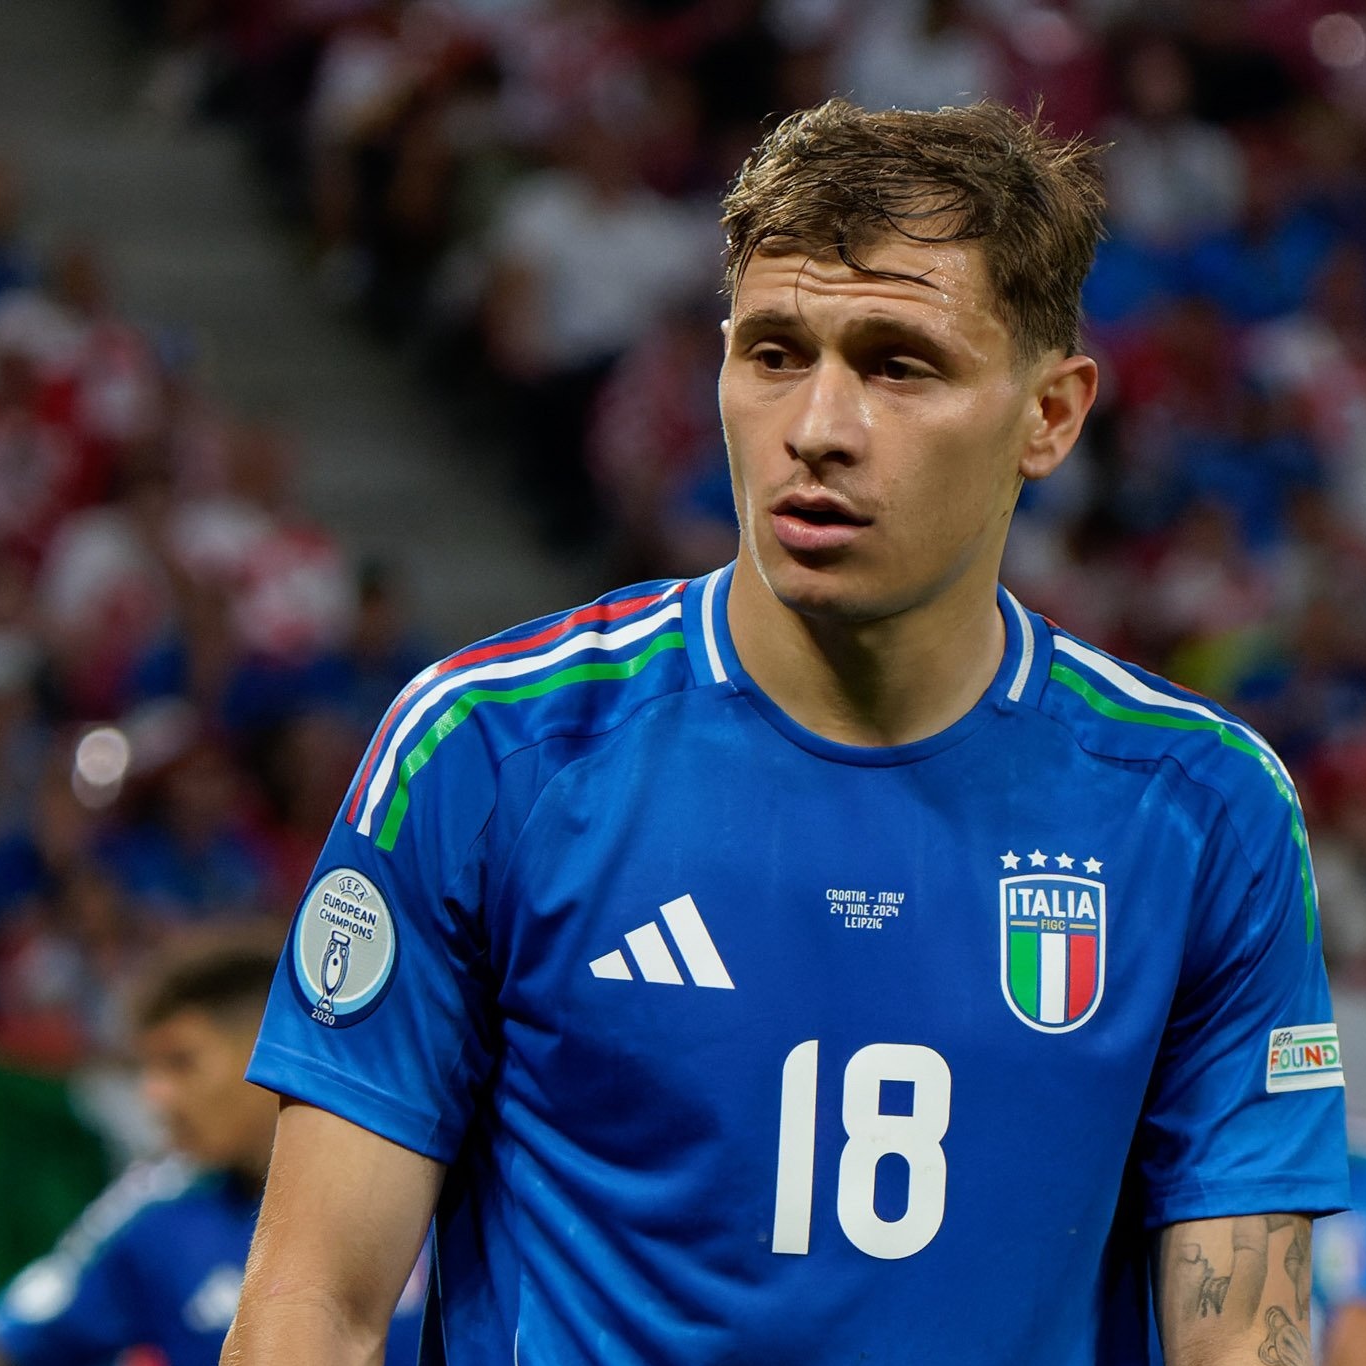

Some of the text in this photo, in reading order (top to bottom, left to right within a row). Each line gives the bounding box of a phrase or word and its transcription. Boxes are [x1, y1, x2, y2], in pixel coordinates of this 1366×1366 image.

[339, 879, 366, 901] UEFA
[826, 889, 866, 902] CROATIA
[878, 892, 905, 904] ITALY
[323, 892, 377, 926] EUROPEAN
[830, 902, 899, 917] 24 JUNE 2024
[1009, 888, 1096, 919] ITALIA
[320, 908, 374, 940] CHAMPIONS
[845, 916, 883, 929] LEIPZIG
[1041, 919, 1066, 930] FIGC
[311, 1007, 336, 1026] 2020
[1270, 1044, 1340, 1072] FOUND
[772, 1039, 952, 1260] 18
